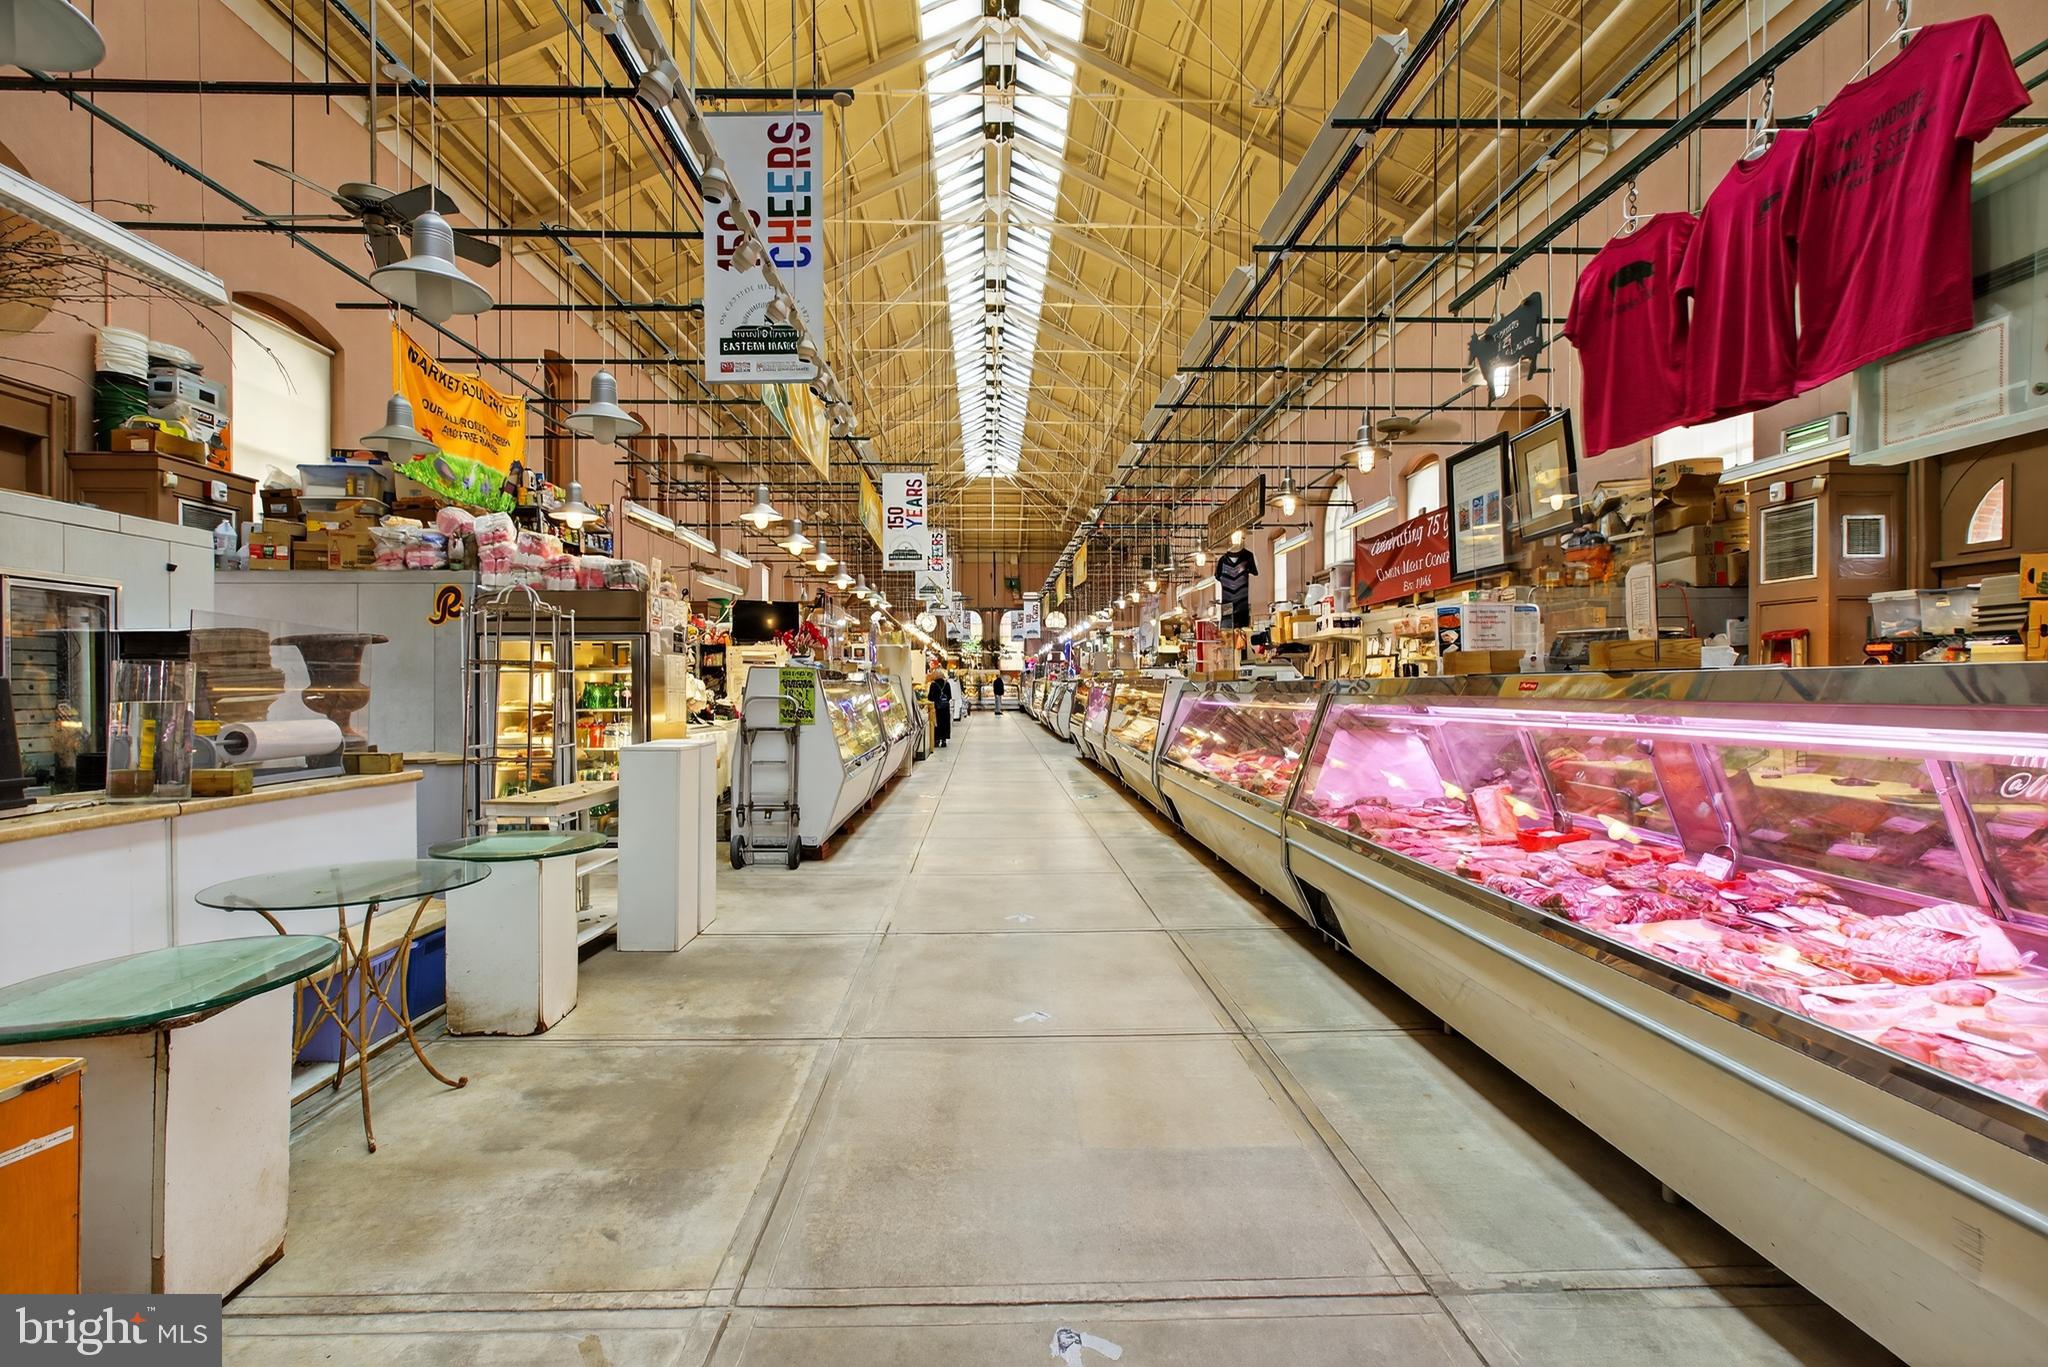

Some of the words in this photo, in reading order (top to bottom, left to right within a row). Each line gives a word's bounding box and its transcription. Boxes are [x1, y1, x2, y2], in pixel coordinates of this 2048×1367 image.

[767, 122, 812, 268] CHEERS
[723, 341, 766, 351] EASTERN
[768, 341, 799, 351] MARK
[906, 478, 923, 530] YEARS
[887, 507, 904, 530] 150
[1426, 513, 1442, 537] 75
